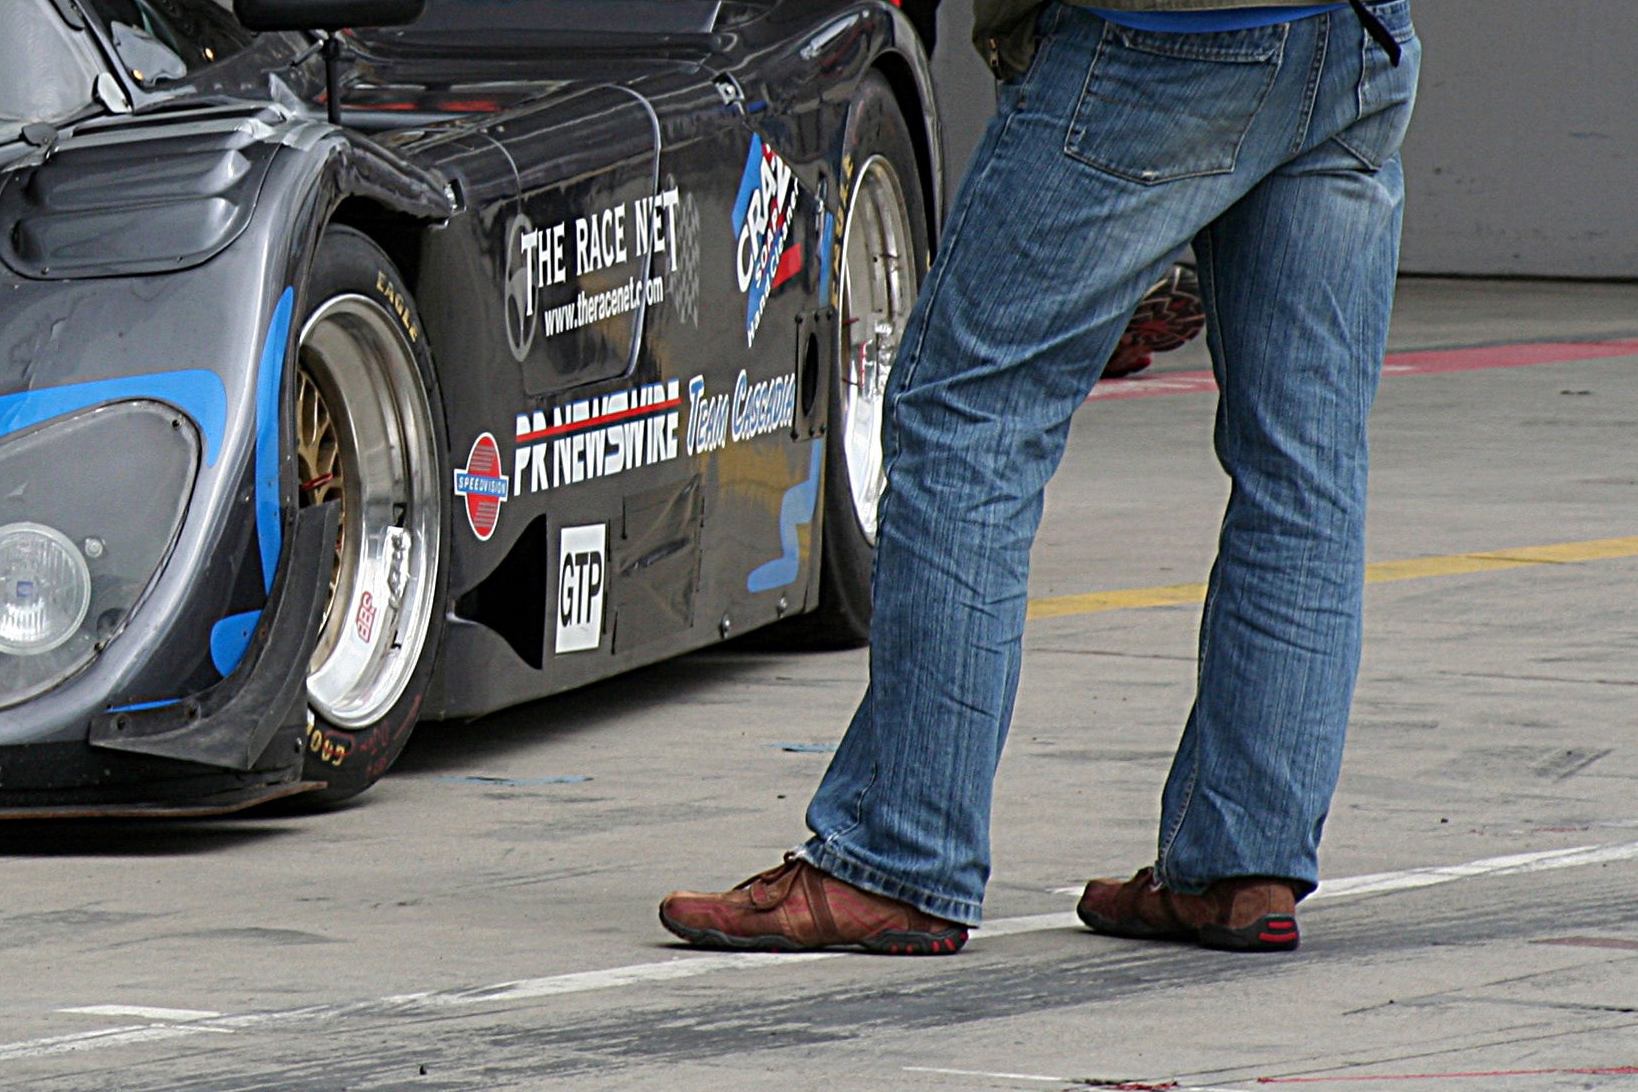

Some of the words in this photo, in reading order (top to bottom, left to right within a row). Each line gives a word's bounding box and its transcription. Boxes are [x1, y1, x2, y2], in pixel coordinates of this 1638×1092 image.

[521, 221, 566, 316] THE
[575, 202, 627, 276] RACE
[634, 185, 679, 272] NET
[755, 209, 779, 289] SOAP
[377, 270, 419, 343] EAGLE
[544, 275, 664, 337] www.theracenet.com
[748, 273, 771, 348] Hand
[514, 410, 548, 497] PR
[553, 378, 681, 488] NEWSWIRE
[561, 551, 602, 628] GTP
